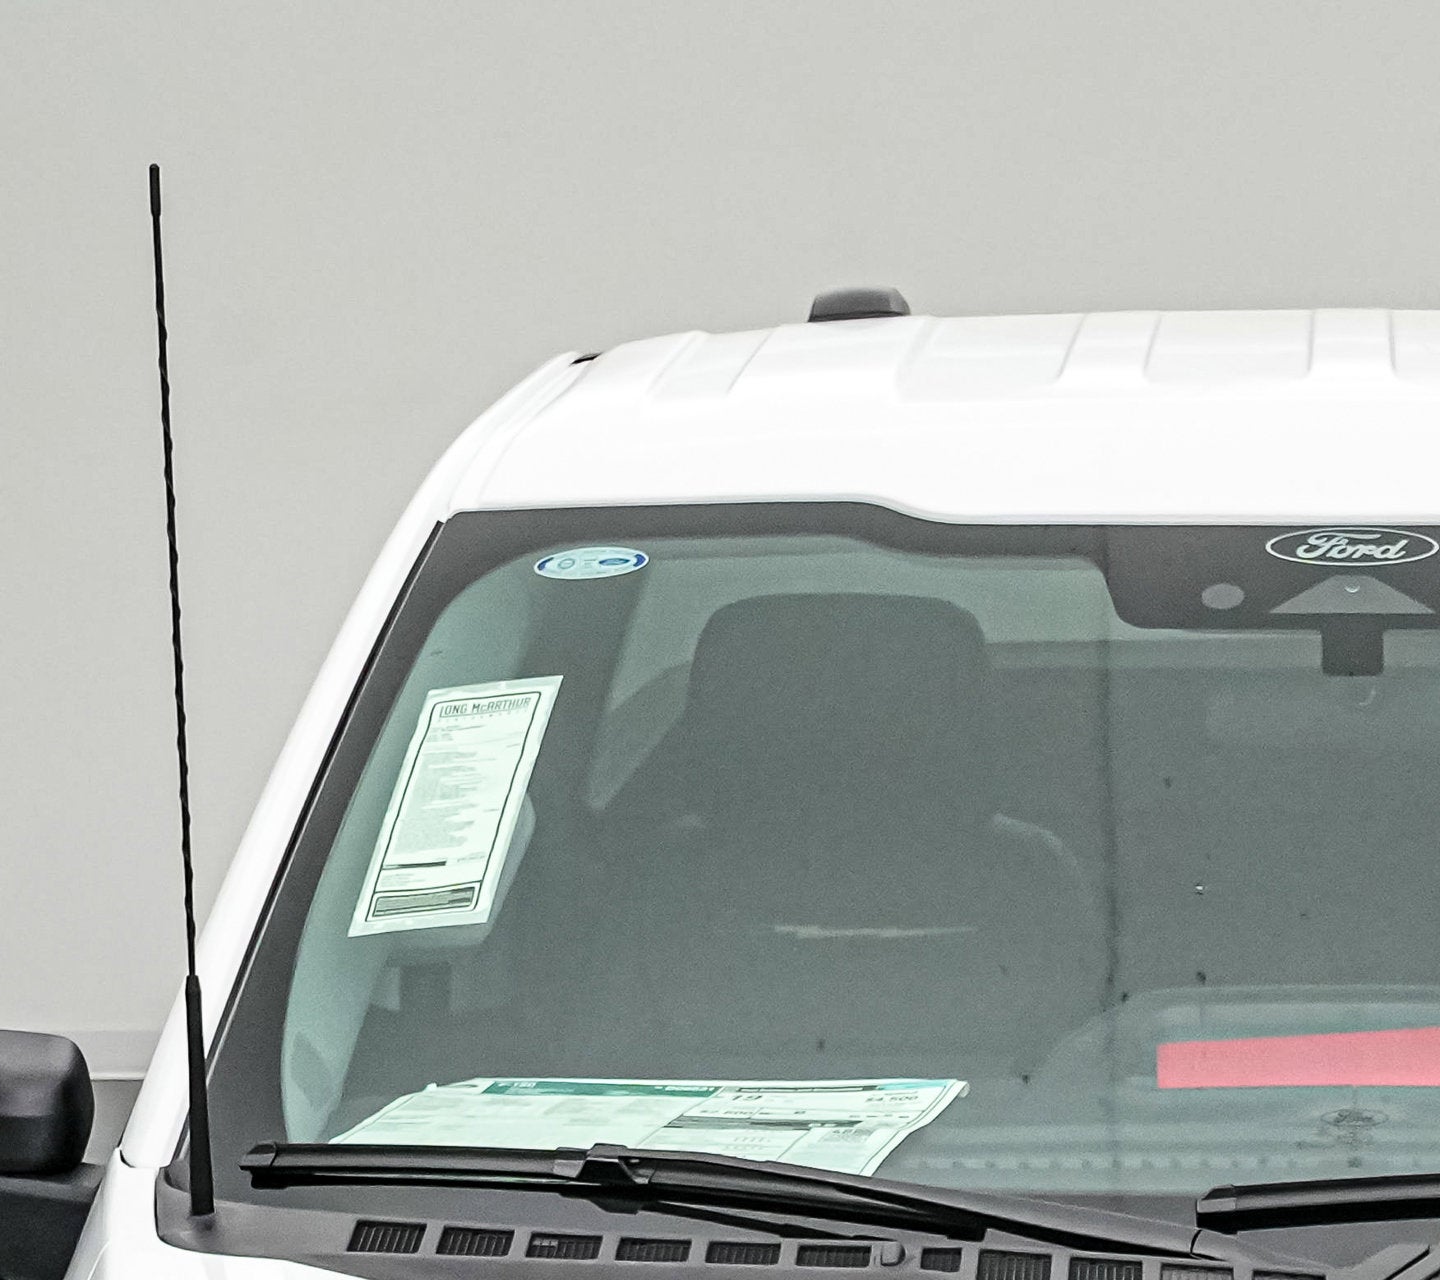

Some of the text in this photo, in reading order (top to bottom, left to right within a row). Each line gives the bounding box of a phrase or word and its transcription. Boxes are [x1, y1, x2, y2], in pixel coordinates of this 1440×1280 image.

[1296, 532, 1409, 559] Ford
[440, 703, 467, 717] LONG
[471, 697, 532, 713] McARTHUR
